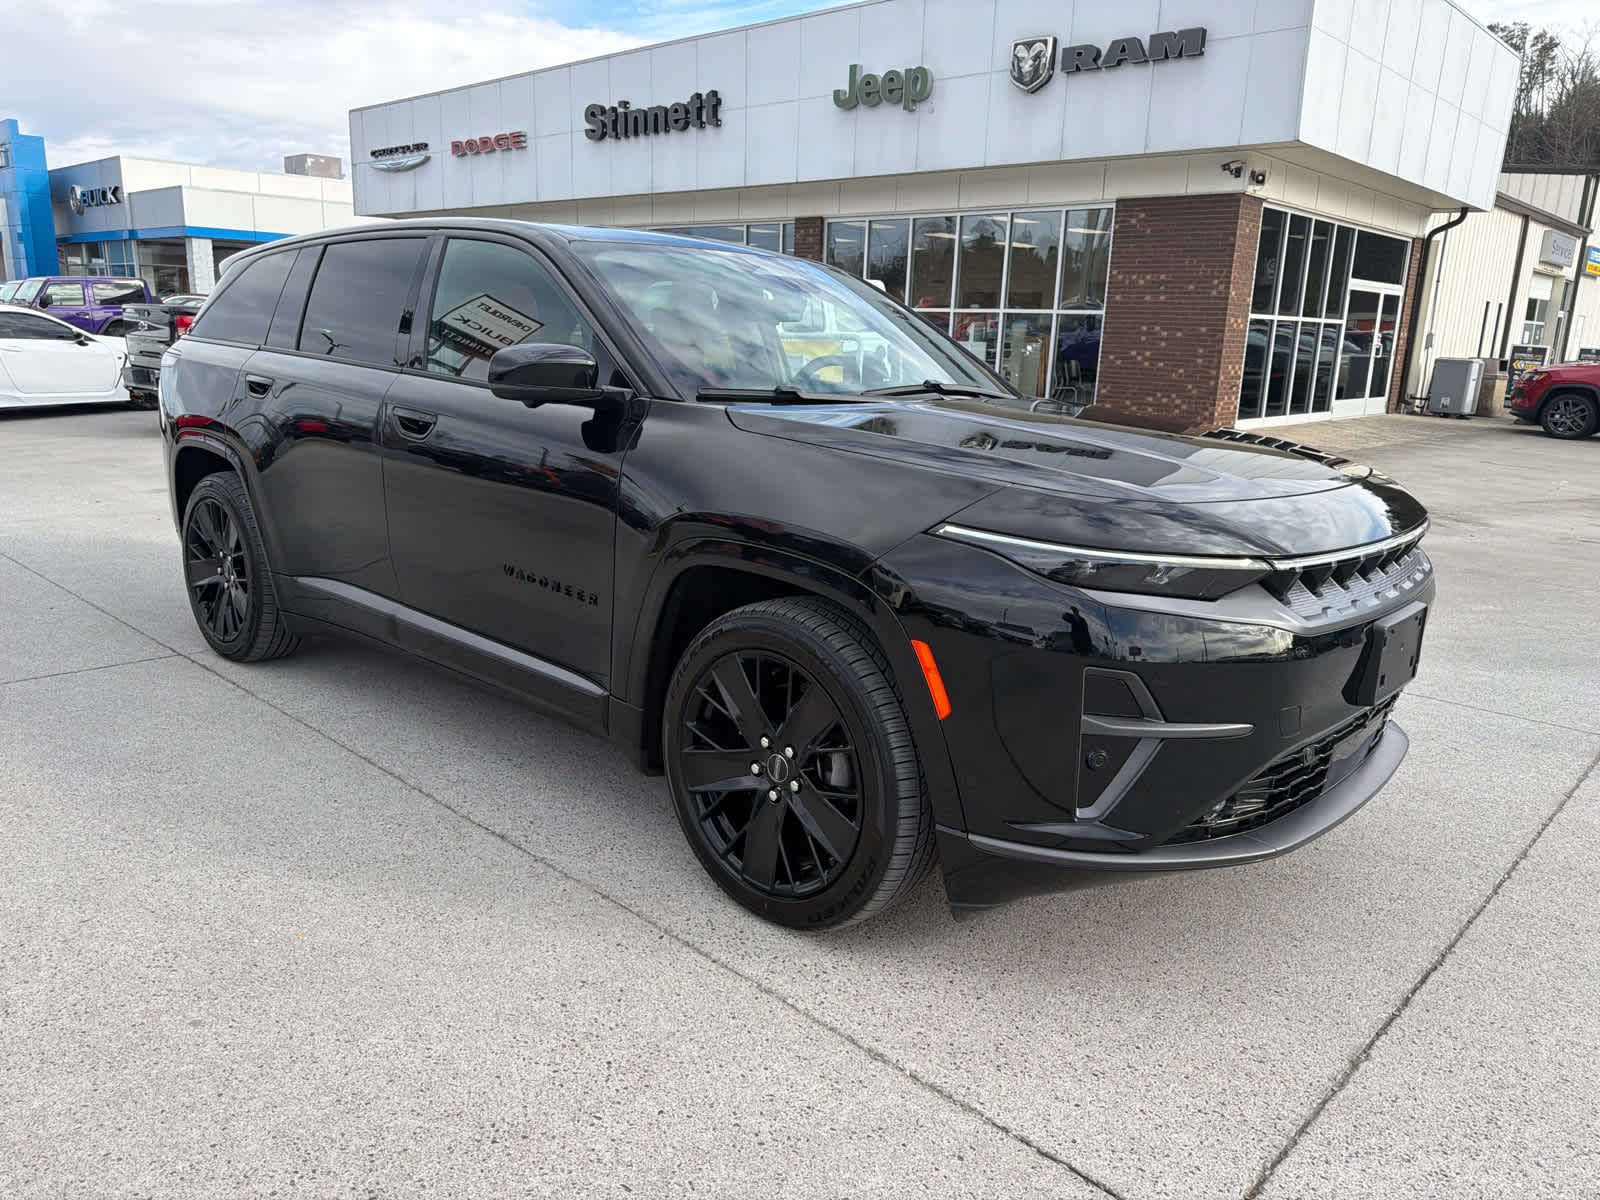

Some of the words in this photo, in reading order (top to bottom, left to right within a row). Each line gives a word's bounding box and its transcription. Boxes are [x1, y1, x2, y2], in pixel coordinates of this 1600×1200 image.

[1060, 27, 1207, 73] RAM
[833, 64, 933, 111] Jeep
[585, 90, 722, 141] Stinnett
[451, 131, 527, 157] DODGE
[80, 185, 121, 208] BUICK
[503, 563, 599, 606] WAGONEER
